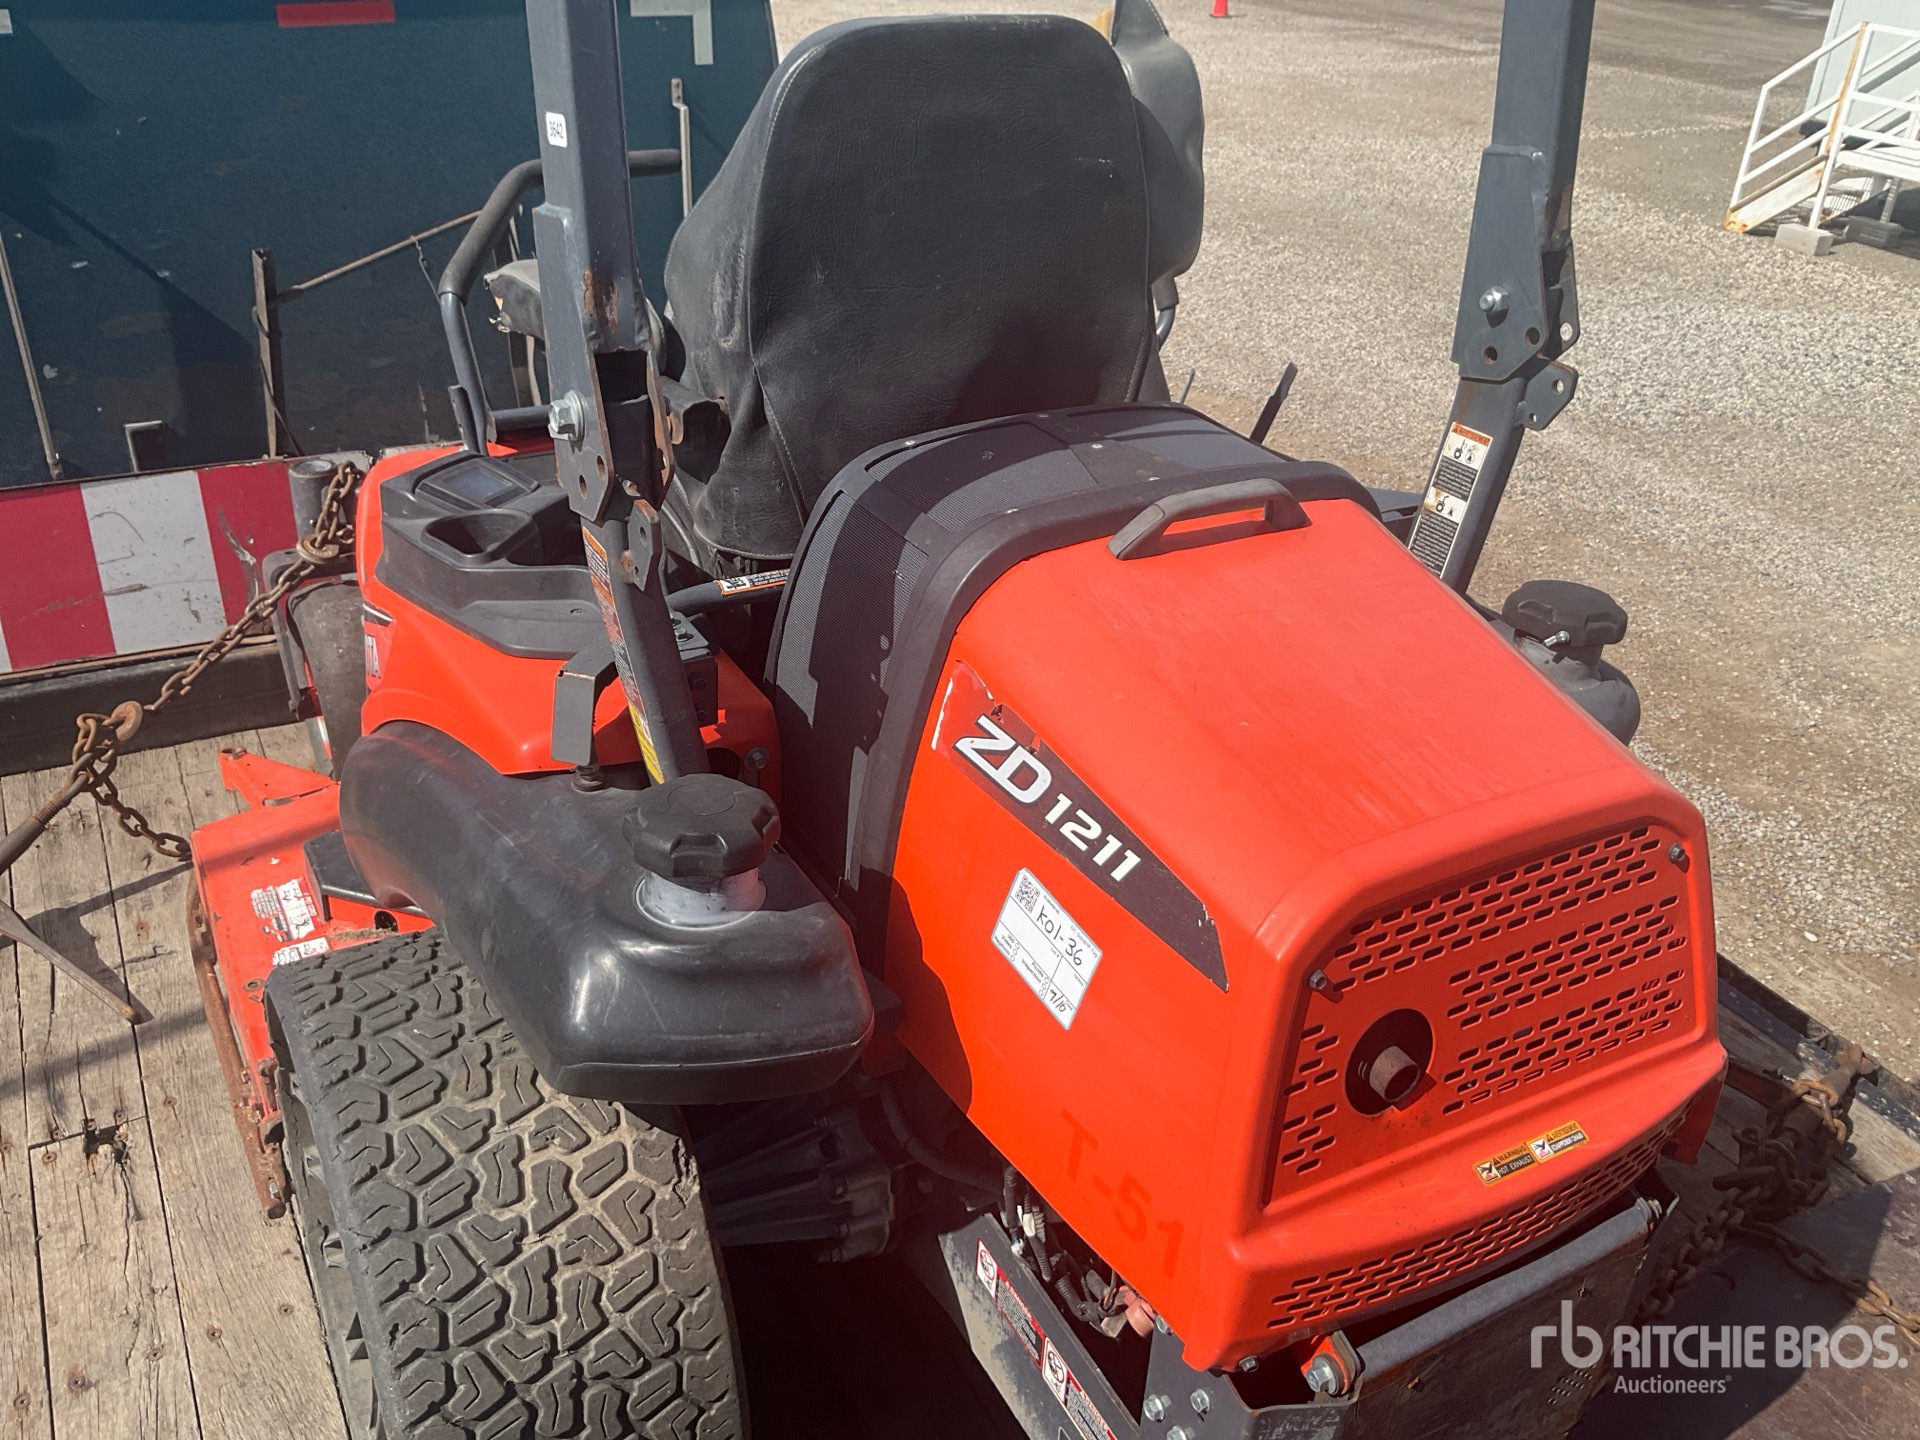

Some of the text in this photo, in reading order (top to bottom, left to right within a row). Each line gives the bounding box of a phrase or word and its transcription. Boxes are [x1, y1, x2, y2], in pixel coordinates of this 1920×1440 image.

[1497, 1146, 1527, 1162] WARNING
[1498, 1155, 1533, 1176] HOT EXHAUST
[1062, 1109, 1185, 1279] T-51
